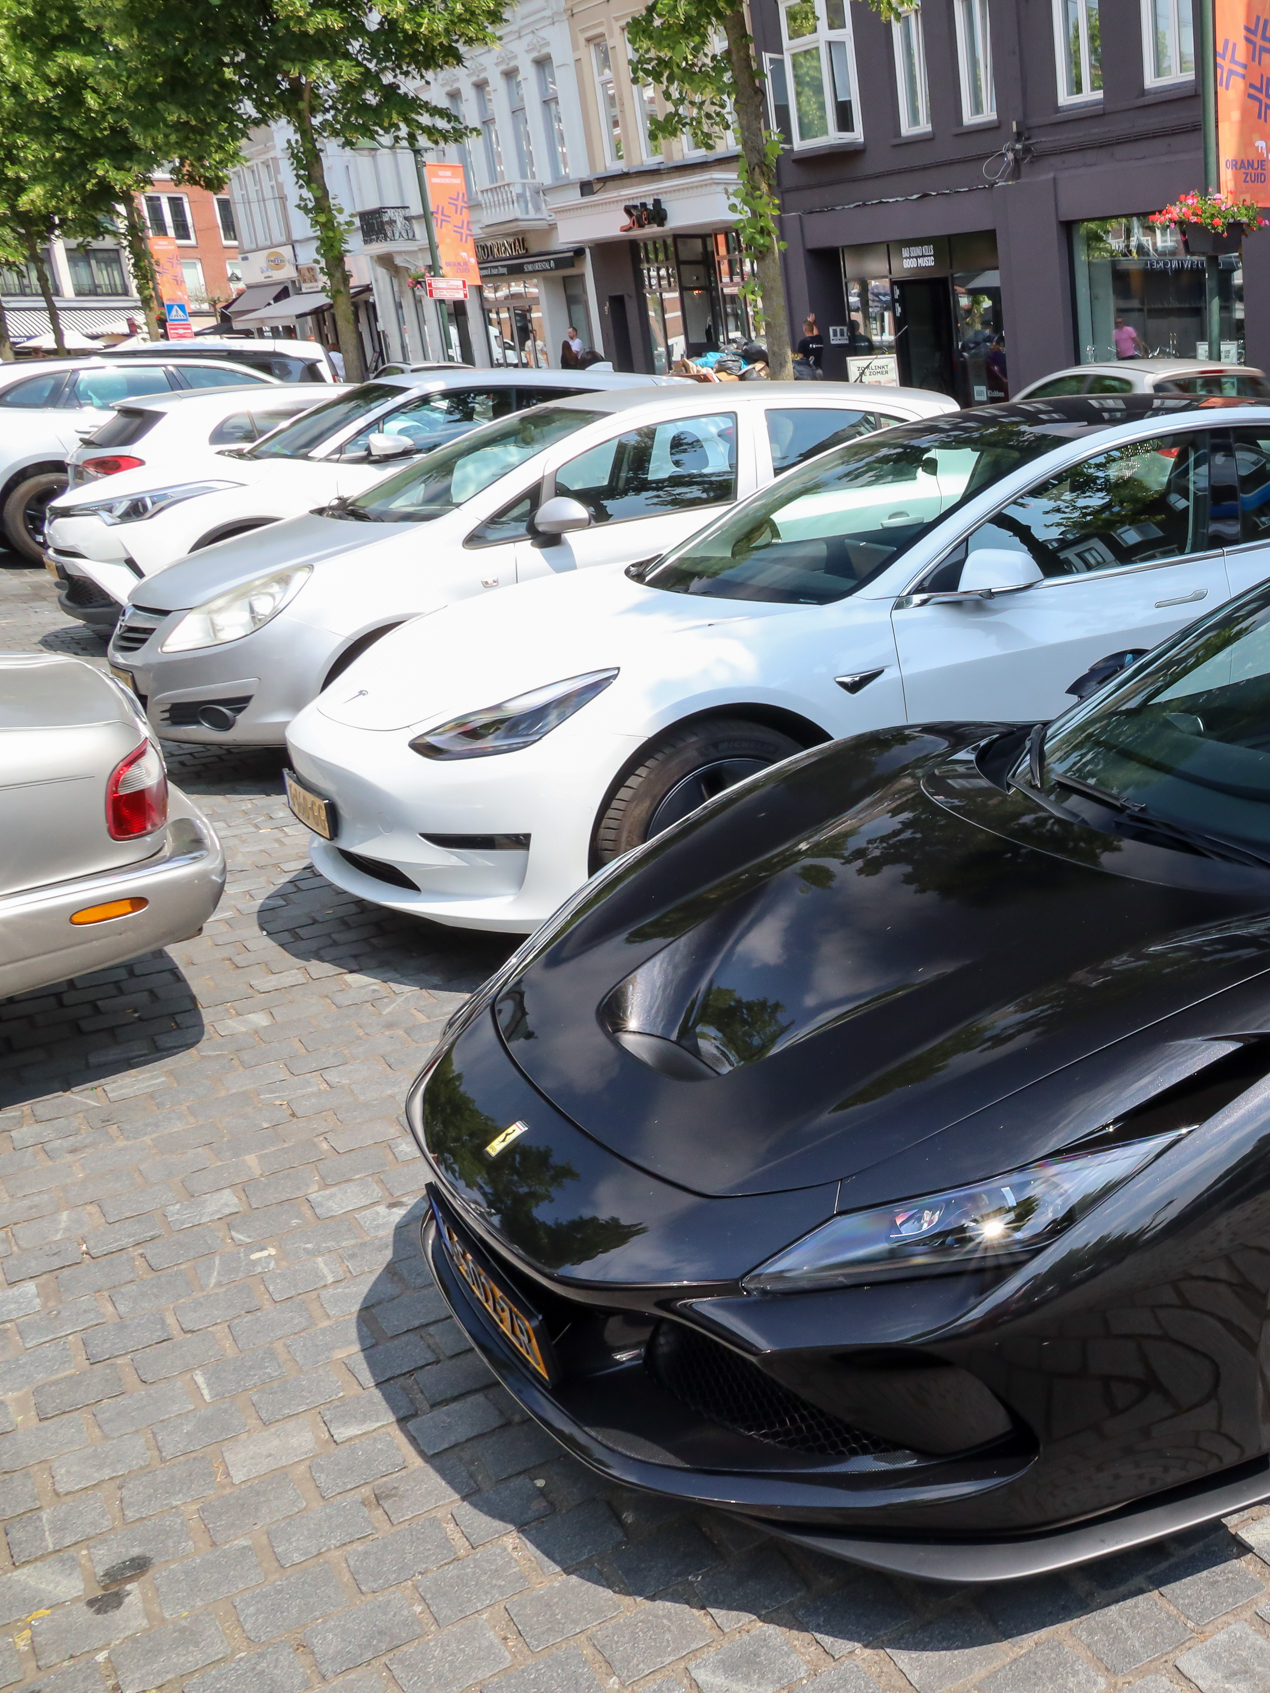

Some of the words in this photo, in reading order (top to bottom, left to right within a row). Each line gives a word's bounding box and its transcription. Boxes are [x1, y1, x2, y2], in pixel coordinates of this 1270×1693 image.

[1225, 159, 1266, 171] ORANJE
[1242, 172, 1267, 184] ZUID
[910, 245, 922, 257] SOUND
[922, 244, 934, 256] KILLS
[903, 258, 917, 268] GOOD
[917, 256, 935, 267] MUSIC
